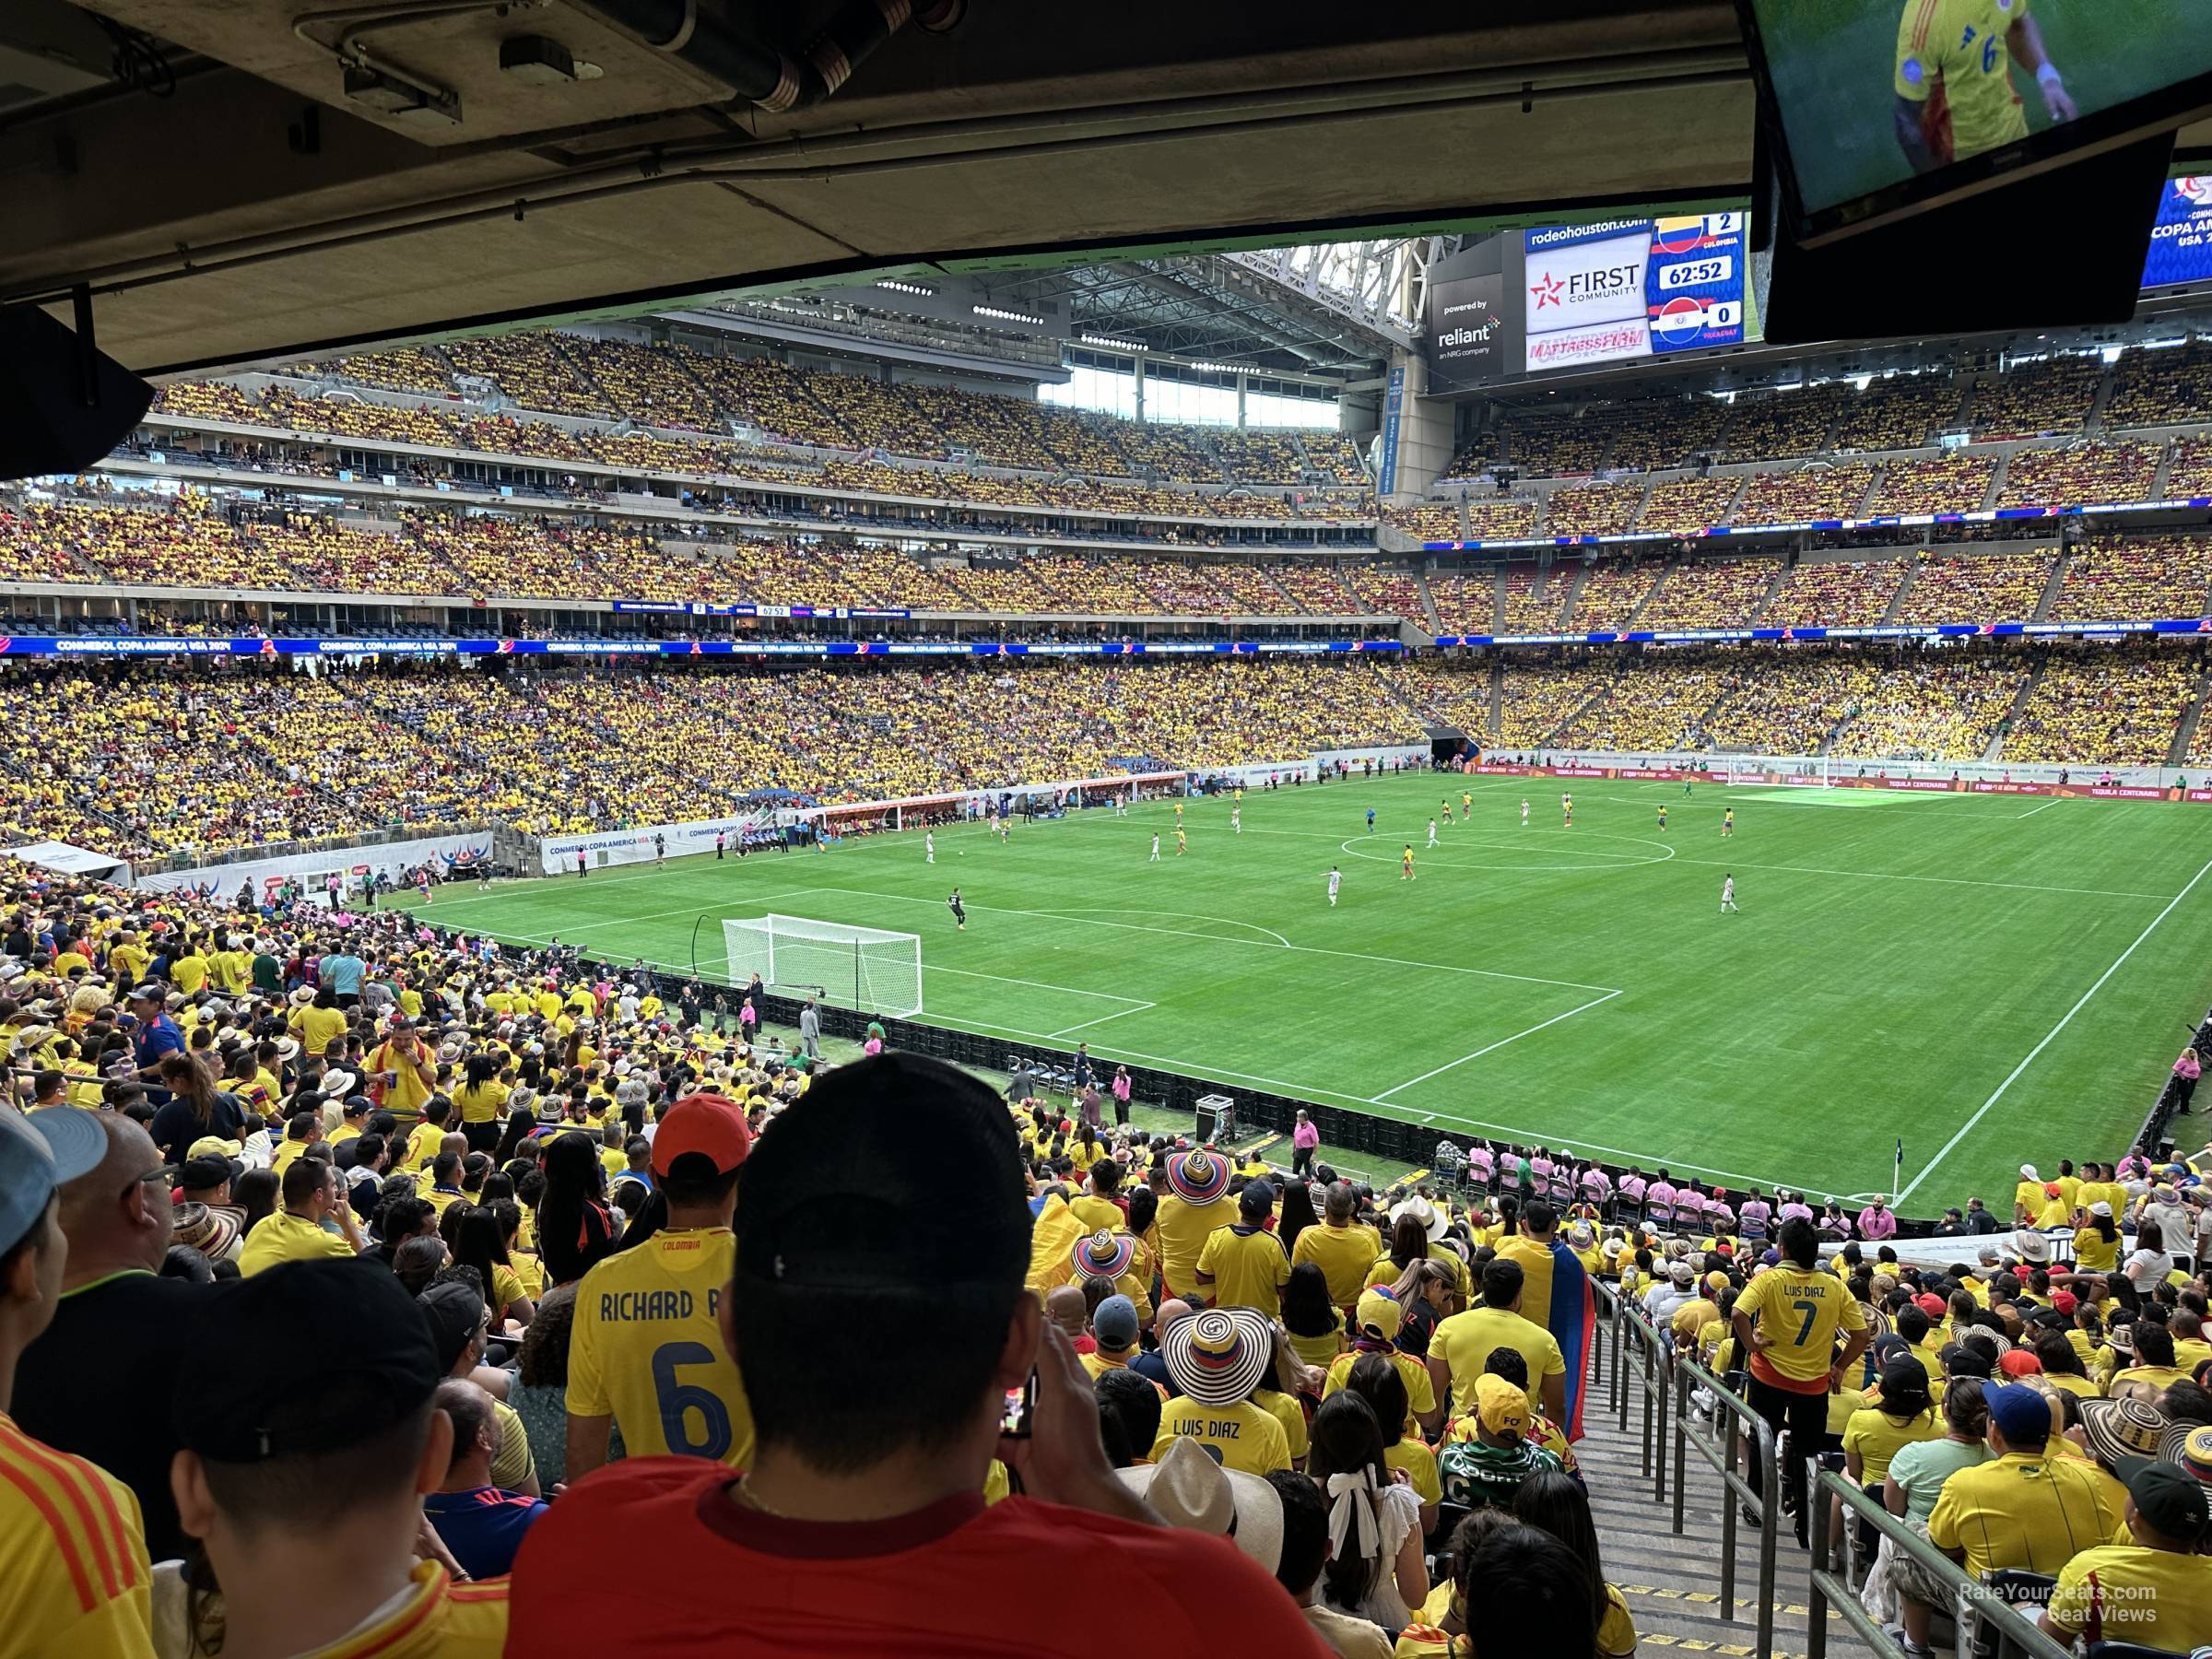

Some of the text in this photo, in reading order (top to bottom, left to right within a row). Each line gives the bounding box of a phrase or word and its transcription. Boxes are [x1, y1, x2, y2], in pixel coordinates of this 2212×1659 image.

[1982, 34, 1998, 74] 6
[1720, 213, 1731, 230] 2
[1531, 218, 1648, 245] rodeohouston.com
[2150, 222, 2193, 240] COPA
[1703, 237, 1738, 249] COLOMBIA
[2178, 234, 2203, 247] USA
[1569, 265, 1640, 295] FIRST
[1669, 261, 1722, 286] 62:52
[1569, 286, 1639, 303] COMMUNITY
[1443, 300, 1487, 315] powered by
[1717, 308, 1730, 324] 0
[1438, 324, 1490, 347] reliant
[1439, 346, 1490, 360] an NRG company
[56, 641, 230, 651] CONMEBOL COPA AMERICA USA 2024
[319, 641, 457, 651] CONMEBOL COPA AMERICA USA 2024
[2092, 788, 2159, 797] TEQUILA CENTENARIO
[689, 828, 721, 837] CONMEBOL
[549, 844, 588, 854] CONMEBOL
[589, 842, 606, 851] COPA
[608, 837, 637, 848] AMERICA
[647, 1004, 655, 1013] 7
[663, 1241, 700, 1251] COLOMBIA
[1784, 1285, 1826, 1299] LUIS DIAZ
[601, 1290, 693, 1322] RICHARD
[1793, 1300, 1818, 1347] 7
[652, 1341, 732, 1461] 6
[1173, 1419, 1241, 1440] LUIS DIAZ
[1503, 1416, 1522, 1427] FCF
